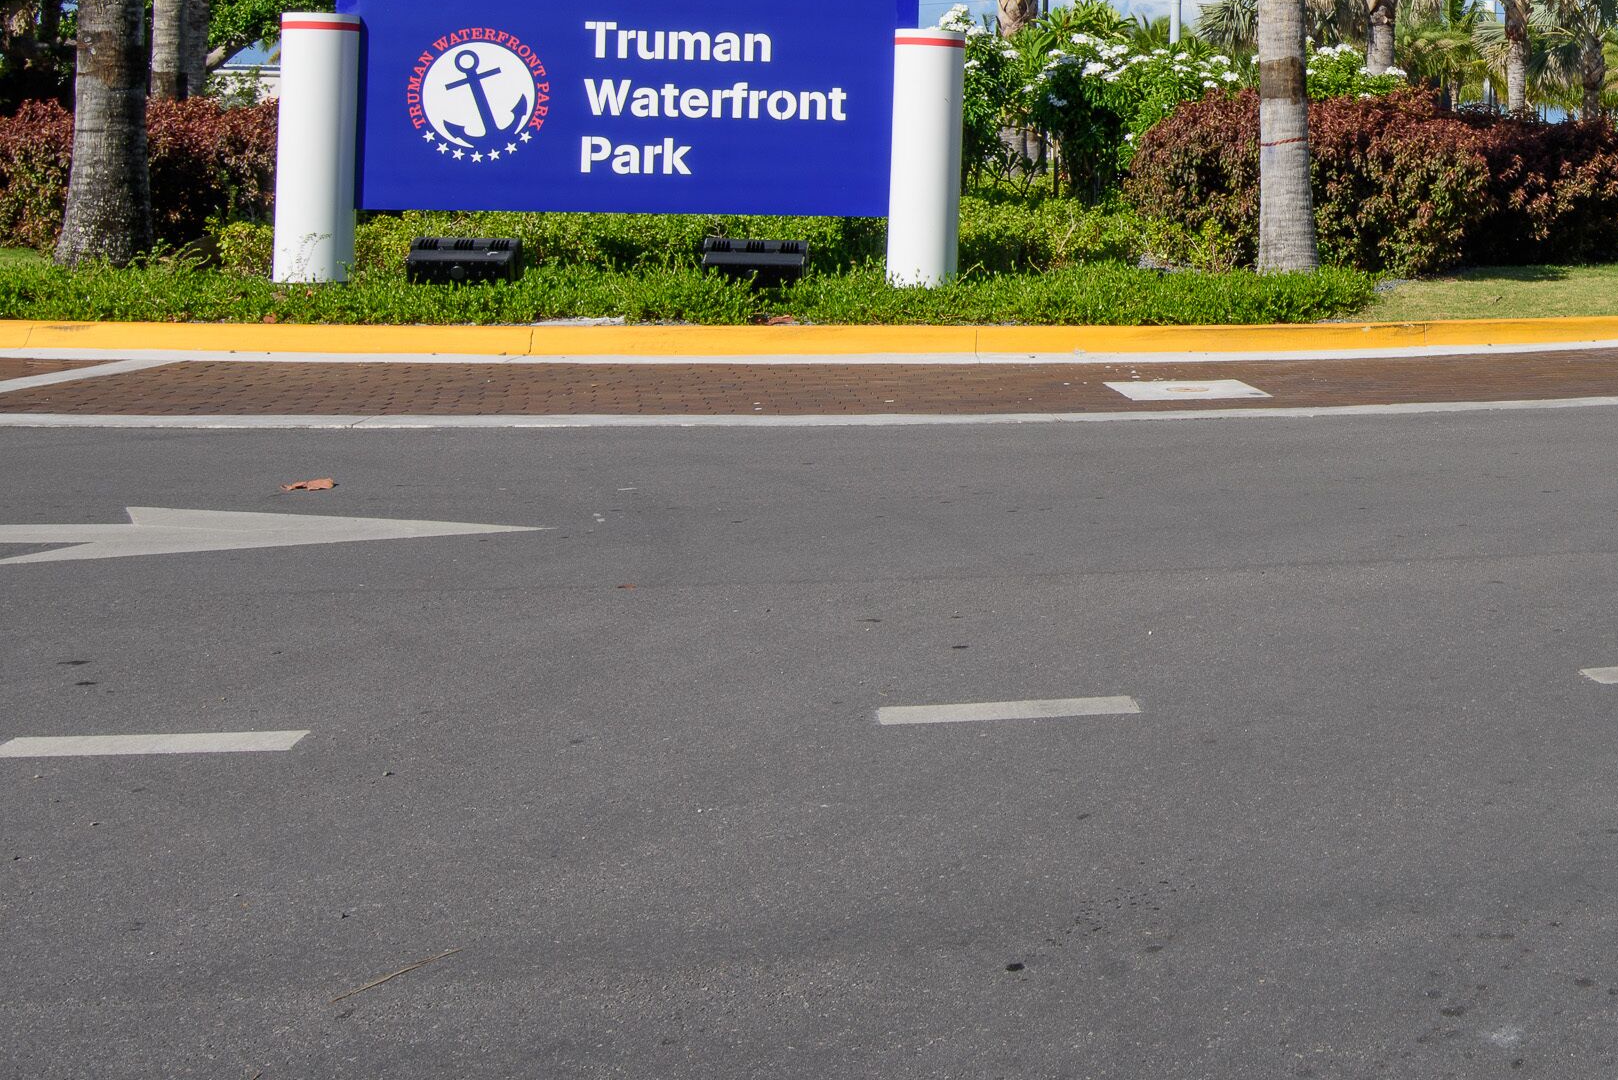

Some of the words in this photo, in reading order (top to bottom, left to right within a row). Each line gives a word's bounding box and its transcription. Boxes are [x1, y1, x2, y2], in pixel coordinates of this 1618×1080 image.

[584, 21, 773, 63] Truman
[408, 50, 434, 129] TRUMAN
[432, 27, 547, 78] WATERFRONT
[528, 82, 551, 132] PARK
[583, 78, 848, 122] Waterfront
[580, 135, 693, 176] Park
